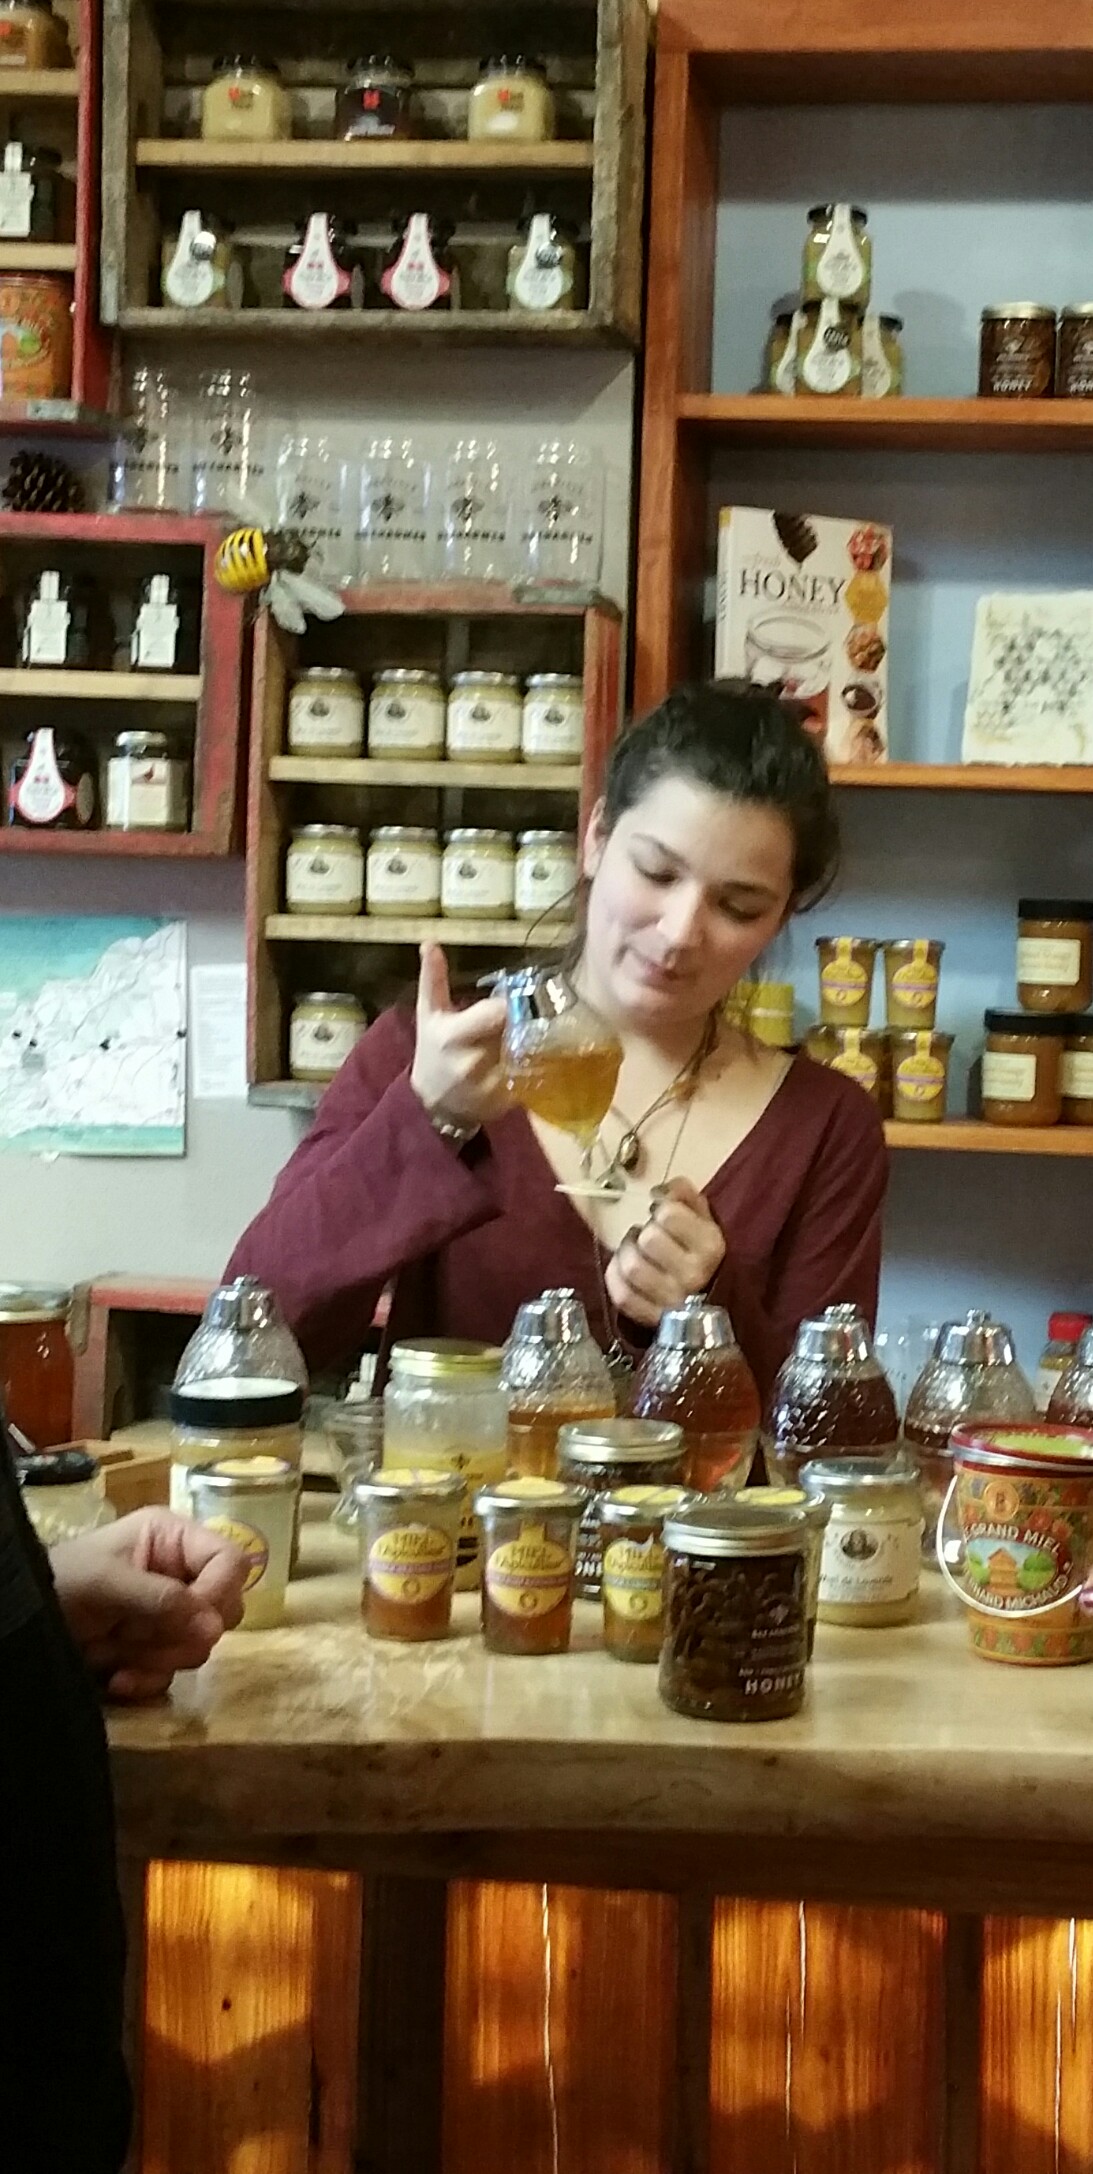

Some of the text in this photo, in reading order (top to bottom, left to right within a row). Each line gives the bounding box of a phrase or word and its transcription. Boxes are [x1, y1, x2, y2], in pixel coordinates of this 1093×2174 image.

[740, 568, 846, 604] HONEY
[971, 1522, 1019, 1541] GRAND
[1023, 1529, 1062, 1556] MIEL
